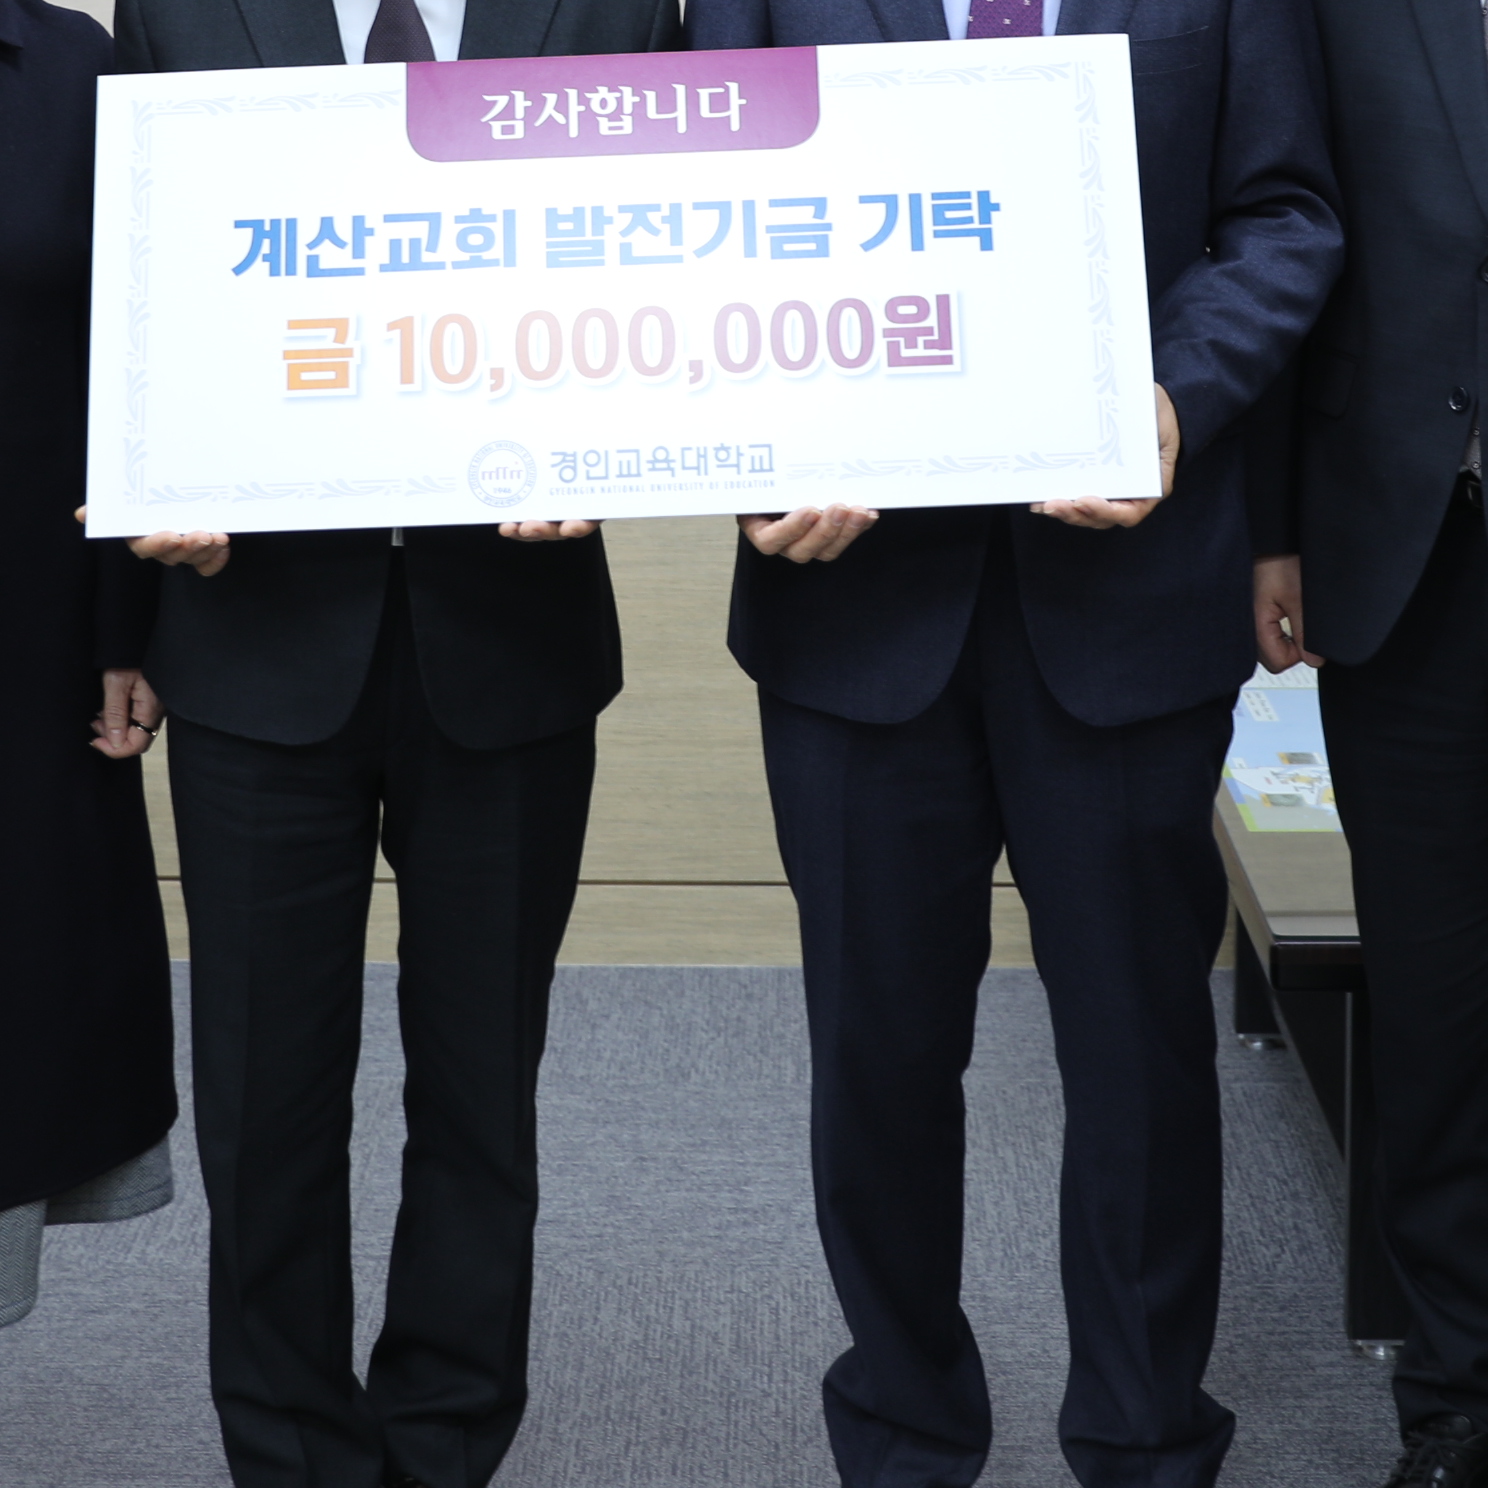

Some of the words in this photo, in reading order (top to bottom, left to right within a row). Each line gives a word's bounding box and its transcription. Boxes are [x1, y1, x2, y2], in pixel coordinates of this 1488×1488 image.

[480, 80, 748, 141] 감사합니다
[231, 207, 518, 279] 계산교회
[544, 196, 834, 269] 발전기금
[858, 189, 1002, 253] 기탁
[282, 316, 355, 391] 금
[385, 293, 955, 394] 10,000,000원
[548, 485, 596, 497] GYEONGIN
[600, 484, 646, 495] NATIONAL
[650, 481, 705, 493] UNIVERSITY
[709, 481, 720, 491] OF
[723, 479, 776, 491] EDUCATION
[549, 442, 776, 484] 경인교육대학교
